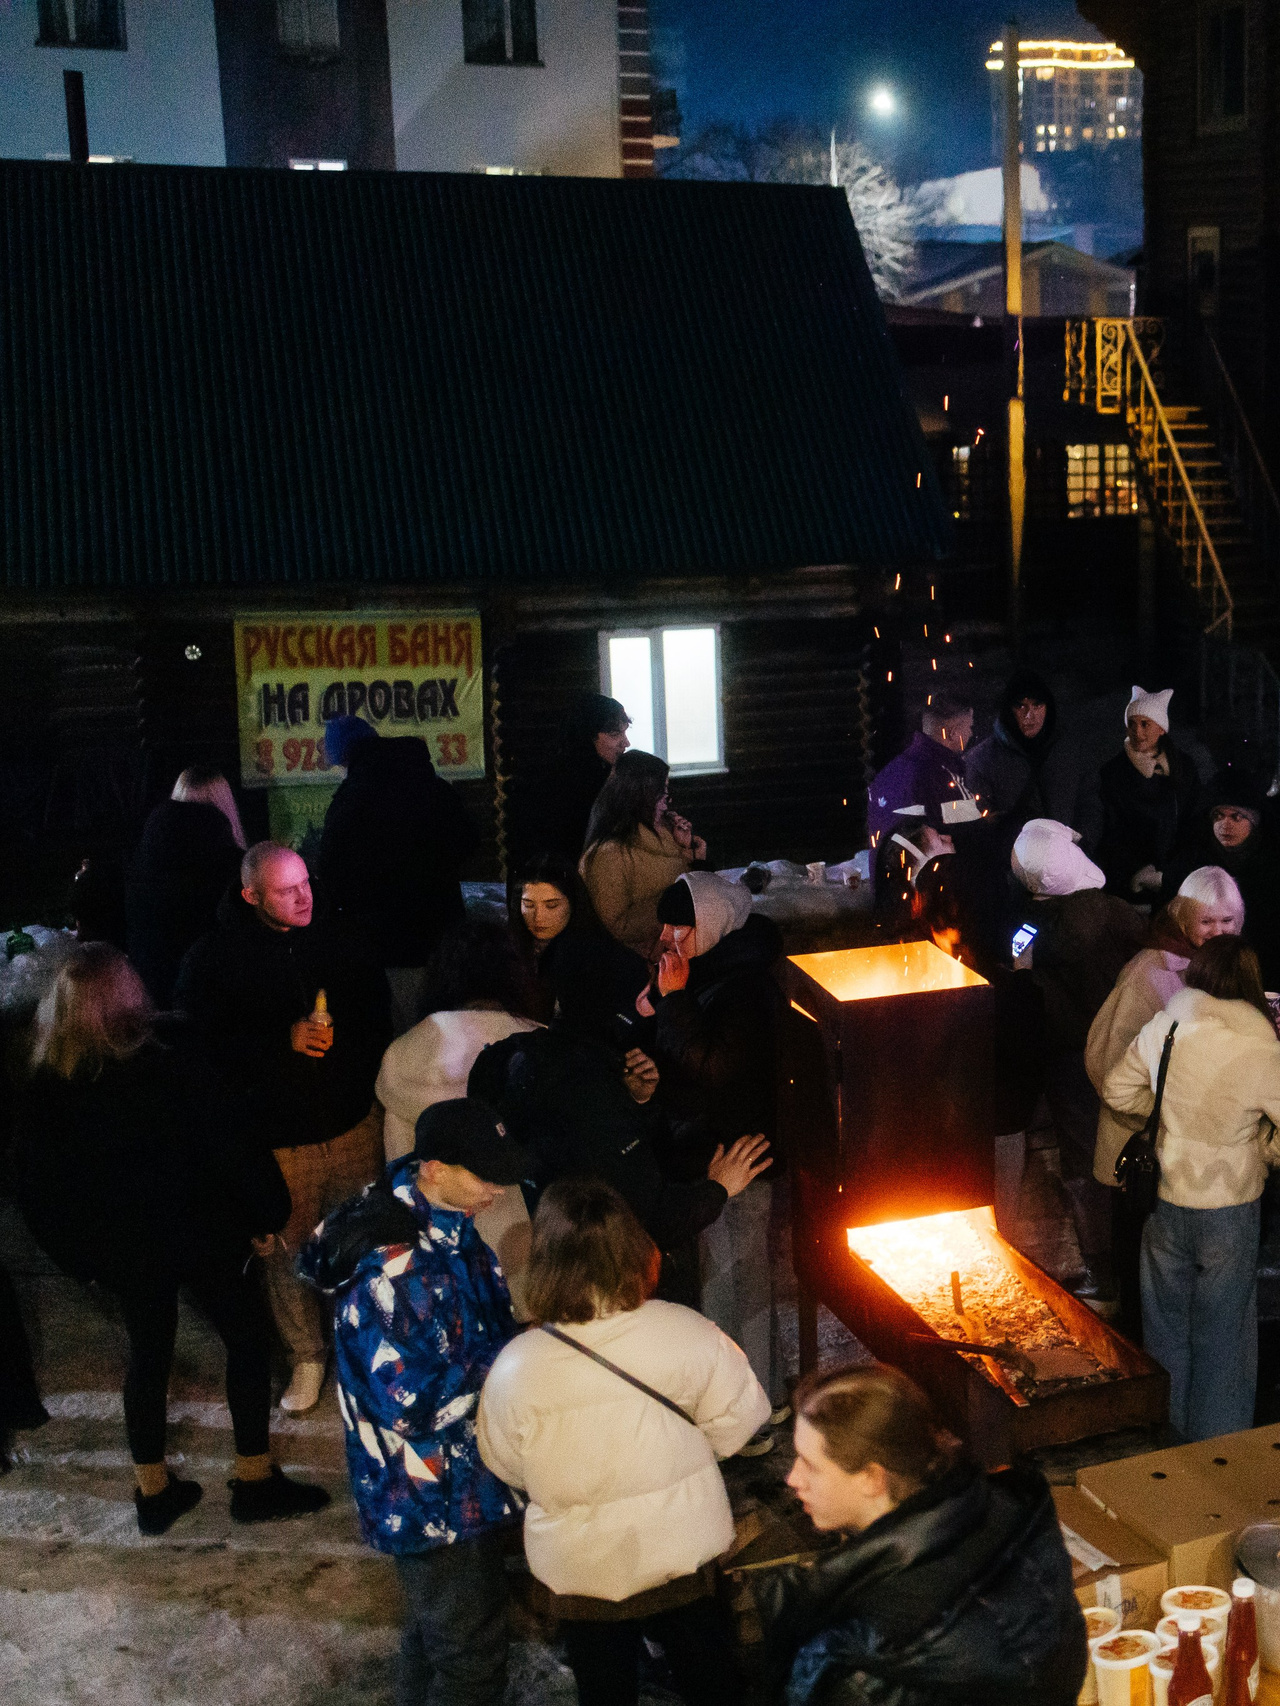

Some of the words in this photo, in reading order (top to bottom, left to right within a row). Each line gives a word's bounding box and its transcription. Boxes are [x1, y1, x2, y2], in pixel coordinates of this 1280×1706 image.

[243, 624, 378, 683] РУССКАЯ
[387, 622, 474, 678] БАНЯ
[261, 682, 310, 728] НА
[320, 679, 460, 722] ДРОВАХ
